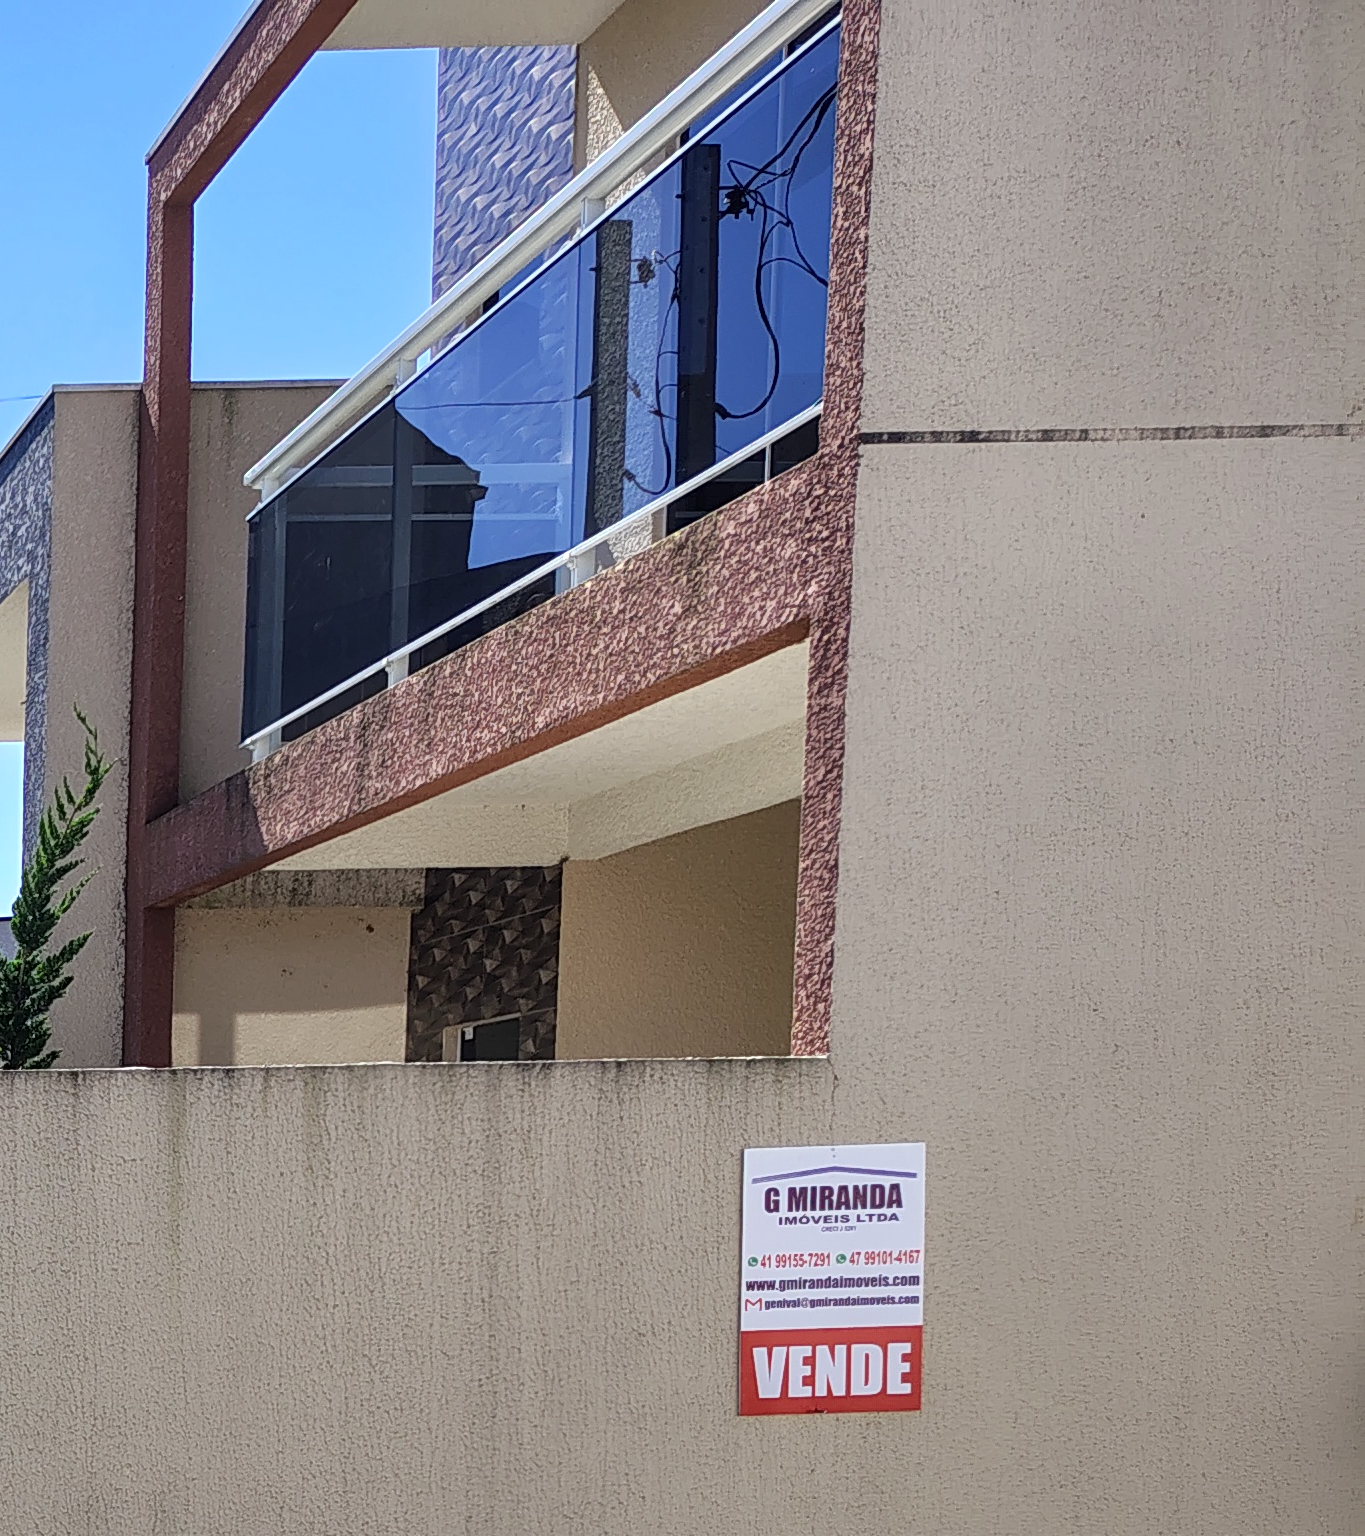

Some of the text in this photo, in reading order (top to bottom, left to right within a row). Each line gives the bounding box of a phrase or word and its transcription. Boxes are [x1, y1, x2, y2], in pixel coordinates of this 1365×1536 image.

[764, 1183, 904, 1214] G MIRANDA
[778, 1212, 900, 1226] IMÓVEIS LTDA
[760, 1249, 921, 1269] 41 99155-7291 47 99101-4167
[745, 1274, 920, 1292] www.gmirandaimoveis.com
[752, 1342, 912, 1399] VENDE
